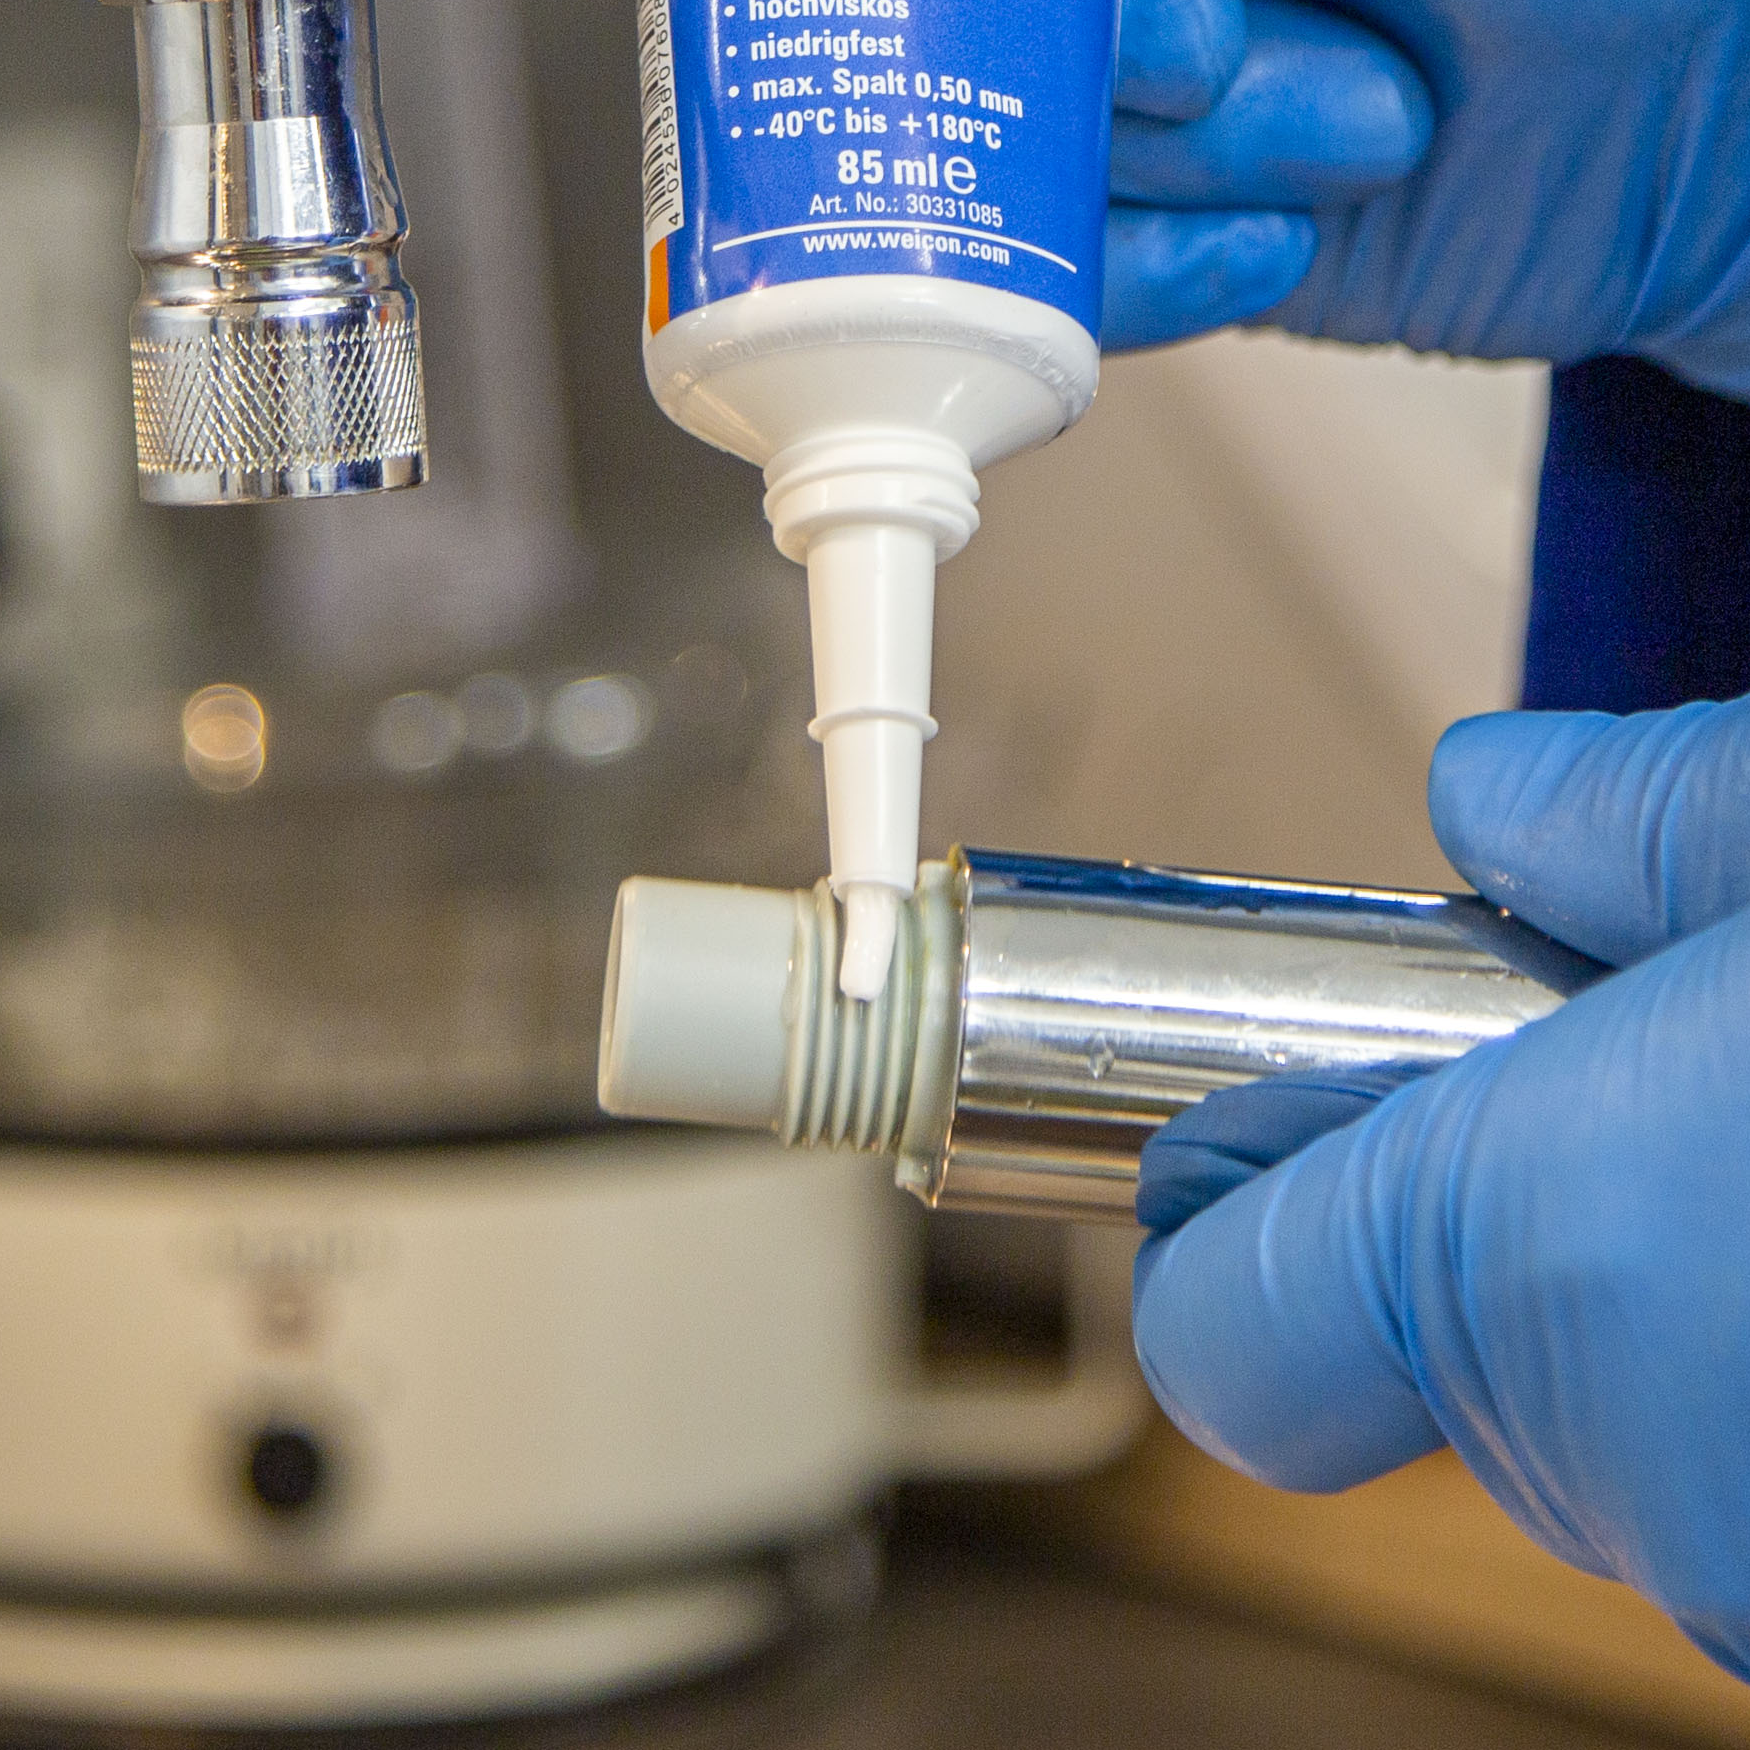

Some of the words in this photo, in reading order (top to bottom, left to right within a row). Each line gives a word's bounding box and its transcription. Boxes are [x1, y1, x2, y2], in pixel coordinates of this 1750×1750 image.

[750, 29, 906, 62] niedrigfest
[752, 76, 823, 102] max.
[832, 67, 908, 100] Spalt
[915, 72, 972, 105] 0,50
[979, 89, 1024, 118] mm
[845, 107, 888, 134] bis
[837, 149, 885, 186] 85
[893, 152, 939, 188] ml
[809, 193, 848, 216] Art.
[855, 192, 899, 213] No.:
[905, 194, 1003, 228] 30331085
[802, 228, 1011, 266] www.weicon.com
